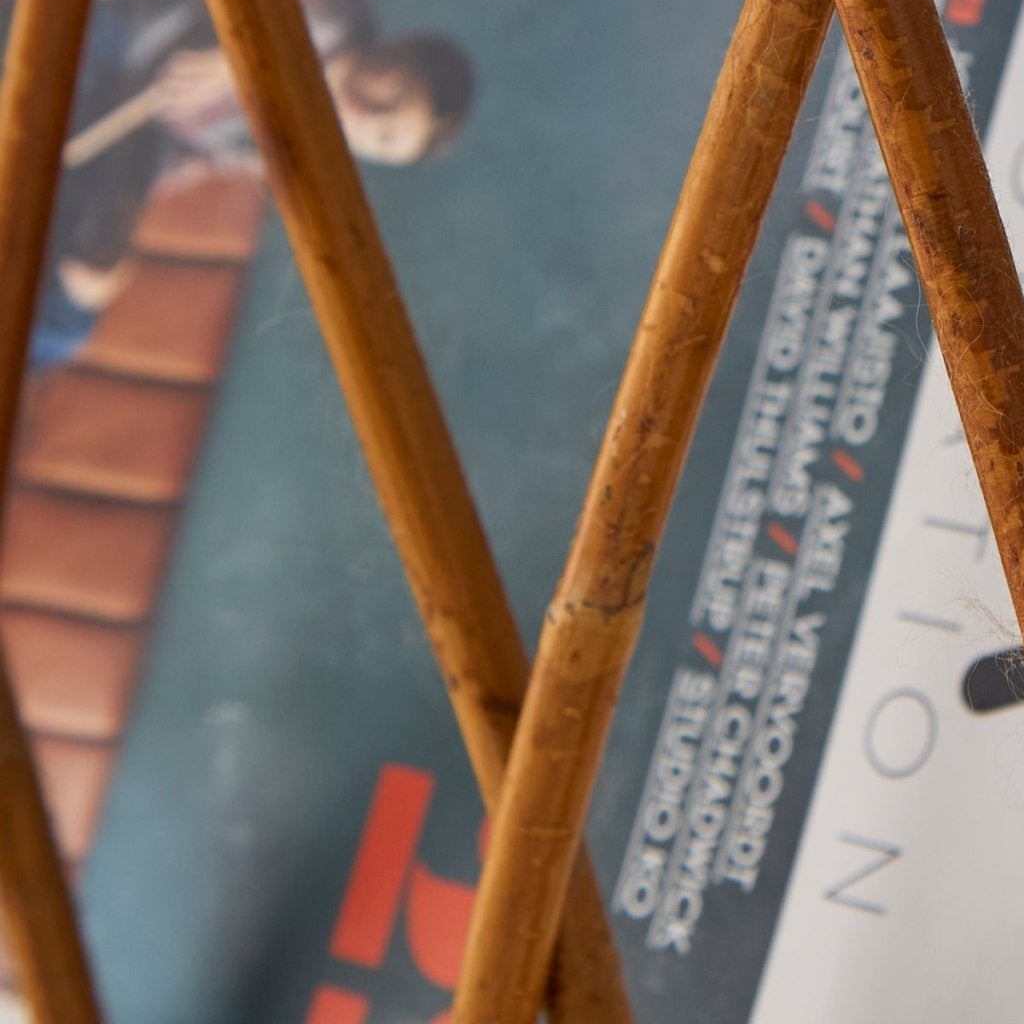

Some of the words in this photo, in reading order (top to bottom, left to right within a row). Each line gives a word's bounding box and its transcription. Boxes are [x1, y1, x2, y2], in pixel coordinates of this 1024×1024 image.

[761, 234, 832, 374] DAVID
[770, 302, 858, 519] WILLIAMS
[694, 377, 796, 632] THULSTRUP
[793, 484, 859, 607] AXEL
[725, 559, 795, 700] PETER
[637, 671, 720, 842] STUDIO
[656, 698, 757, 956] CHADWICK
[721, 609, 825, 890] VERVOORDT
[617, 845, 671, 921] KO
